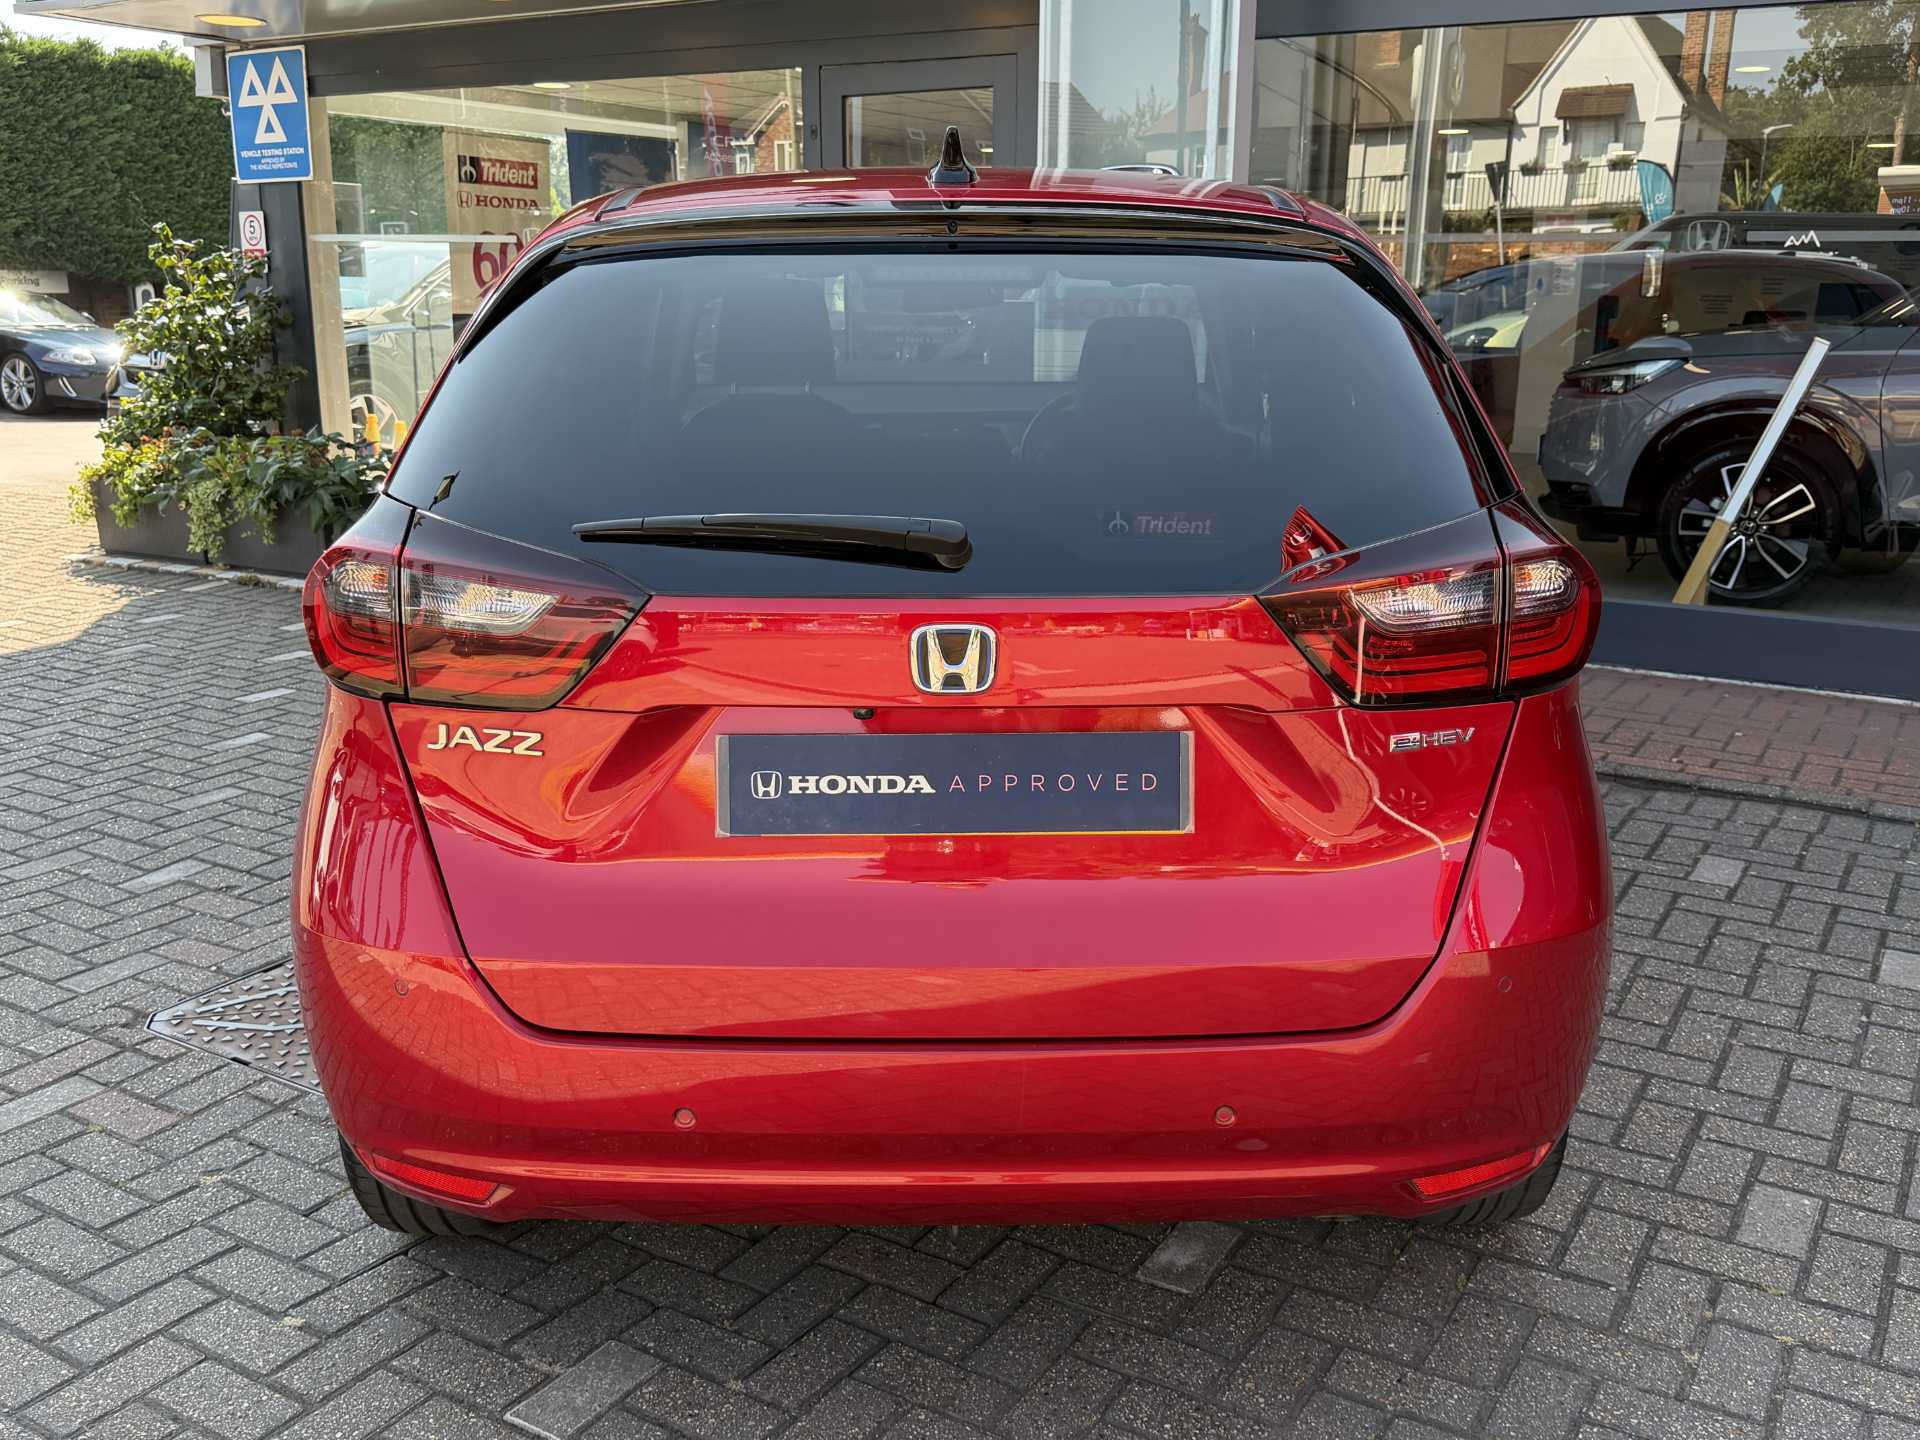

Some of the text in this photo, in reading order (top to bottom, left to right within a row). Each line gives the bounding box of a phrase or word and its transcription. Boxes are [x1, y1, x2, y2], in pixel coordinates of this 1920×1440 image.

[480, 161, 535, 186] Trident
[475, 194, 540, 210] HONDA
[249, 220, 256, 235] 5
[1137, 515, 1211, 535] Trident
[427, 724, 543, 757] JAZZ
[788, 773, 1158, 794] HONDA APPROVED
